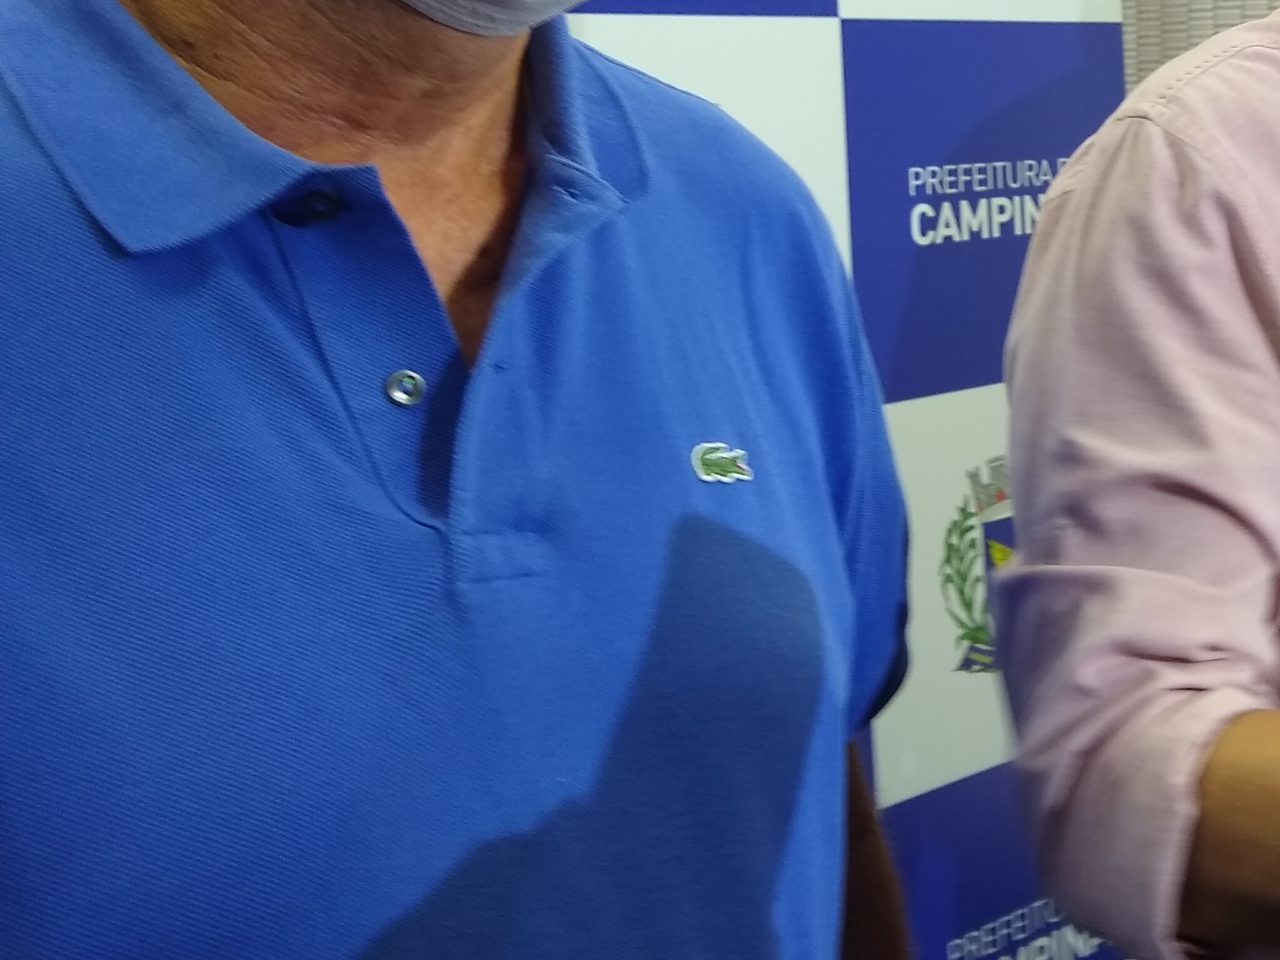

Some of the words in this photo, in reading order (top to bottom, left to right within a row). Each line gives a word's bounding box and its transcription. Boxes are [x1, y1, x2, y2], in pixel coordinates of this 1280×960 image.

[908, 159, 1053, 197] PREFEITURA
[909, 193, 1044, 246] CAMPIN
[946, 898, 1065, 960] PREFEITU
